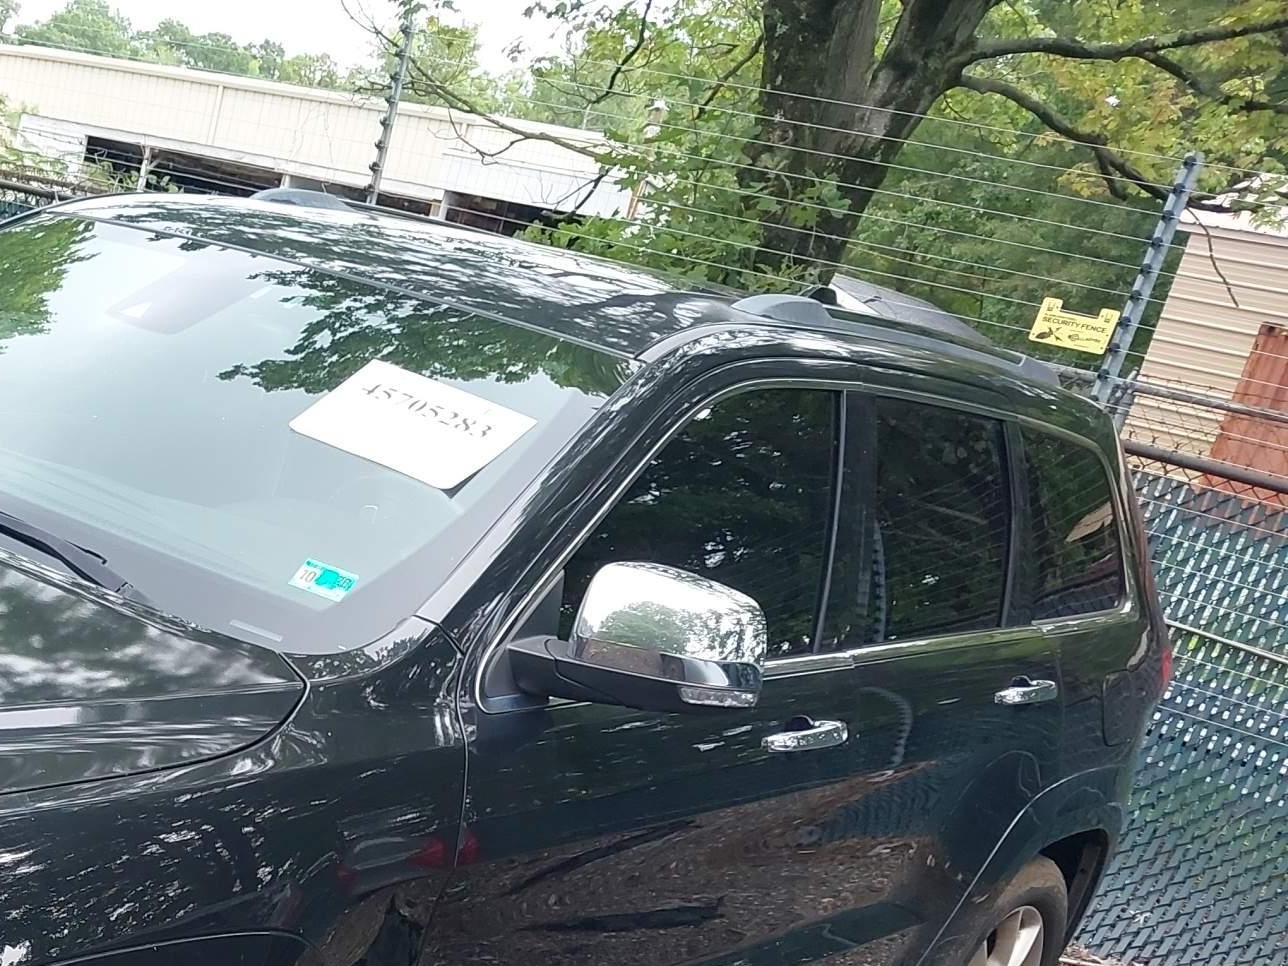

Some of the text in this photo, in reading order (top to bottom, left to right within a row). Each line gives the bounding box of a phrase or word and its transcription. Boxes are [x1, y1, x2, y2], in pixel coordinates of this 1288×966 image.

[1042, 316, 1080, 329] SECURITY
[1080, 323, 1108, 334] FENCE
[362, 383, 493, 438] 45705283
